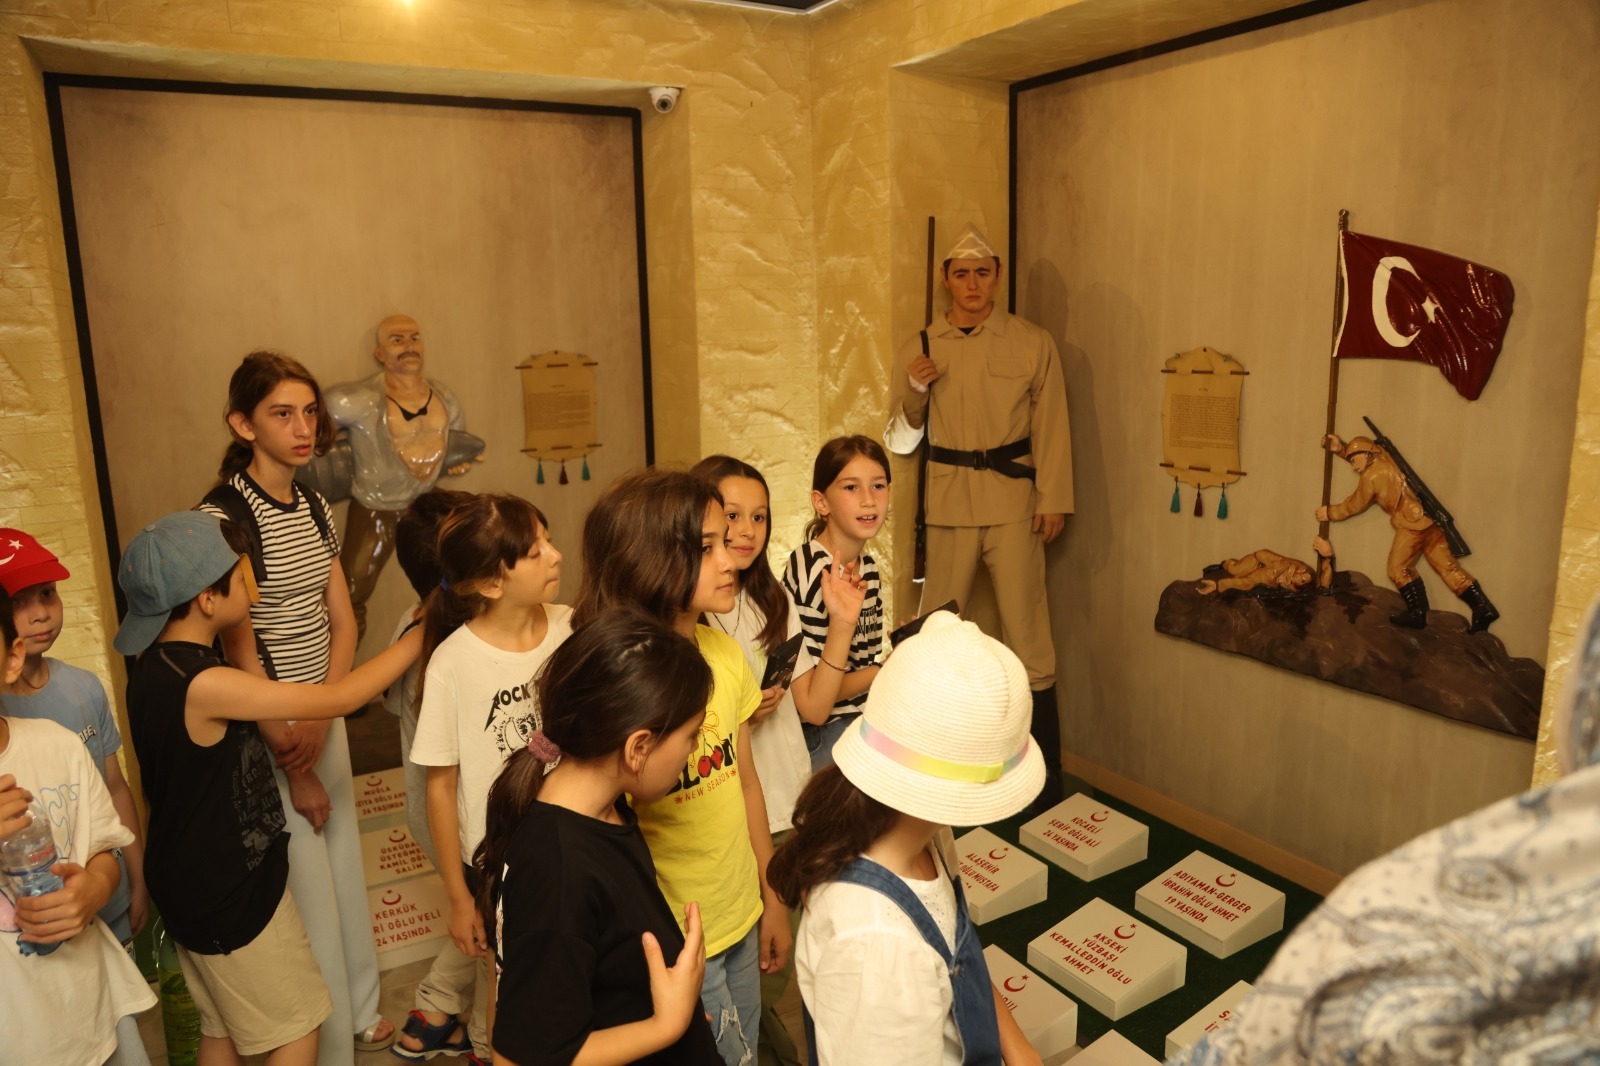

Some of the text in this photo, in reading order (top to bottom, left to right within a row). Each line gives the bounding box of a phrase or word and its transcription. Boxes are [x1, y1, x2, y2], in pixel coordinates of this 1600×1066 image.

[484, 682, 531, 732] ROCK
[364, 786, 391, 796] MUĞLA
[685, 771, 730, 801] NEW SEASON
[355, 799, 373, 807] ZİYA
[374, 794, 393, 803] OĞLU
[372, 801, 405, 813] YAŞINDA
[1047, 818, 1102, 848] ŞERİF OĞLU ALİ
[1071, 816, 1103, 834] KOCAELİ
[380, 841, 419, 854] ÜSKÜDA
[1043, 829, 1079, 852] 24 YAŞINDA
[379, 853, 427, 870] KAMİL OĞL
[380, 848, 421, 862] ÜSTEĞME
[965, 853, 1000, 875] ALAŞEHİR
[395, 863, 423, 874] SALİM
[972, 873, 1000, 892] MUSTAFA
[1173, 870, 1252, 913] ADIYAMAN-GERGER
[1161, 877, 1240, 922] İBRAHİM OĞLU AHMET
[1164, 896, 1209, 923] 19 YAŞINDA
[372, 907, 441, 934] Rİ OĞLU VELİ
[374, 903, 417, 920] KERKÜK
[376, 926, 432, 946] 24 YAŞINDA
[1093, 932, 1129, 954] AKSEKİ
[1049, 931, 1132, 985] KEMALLEDDİN OĞLU
[1082, 937, 1119, 962] YÜZBAŞI
[1063, 954, 1095, 975] AHMET
